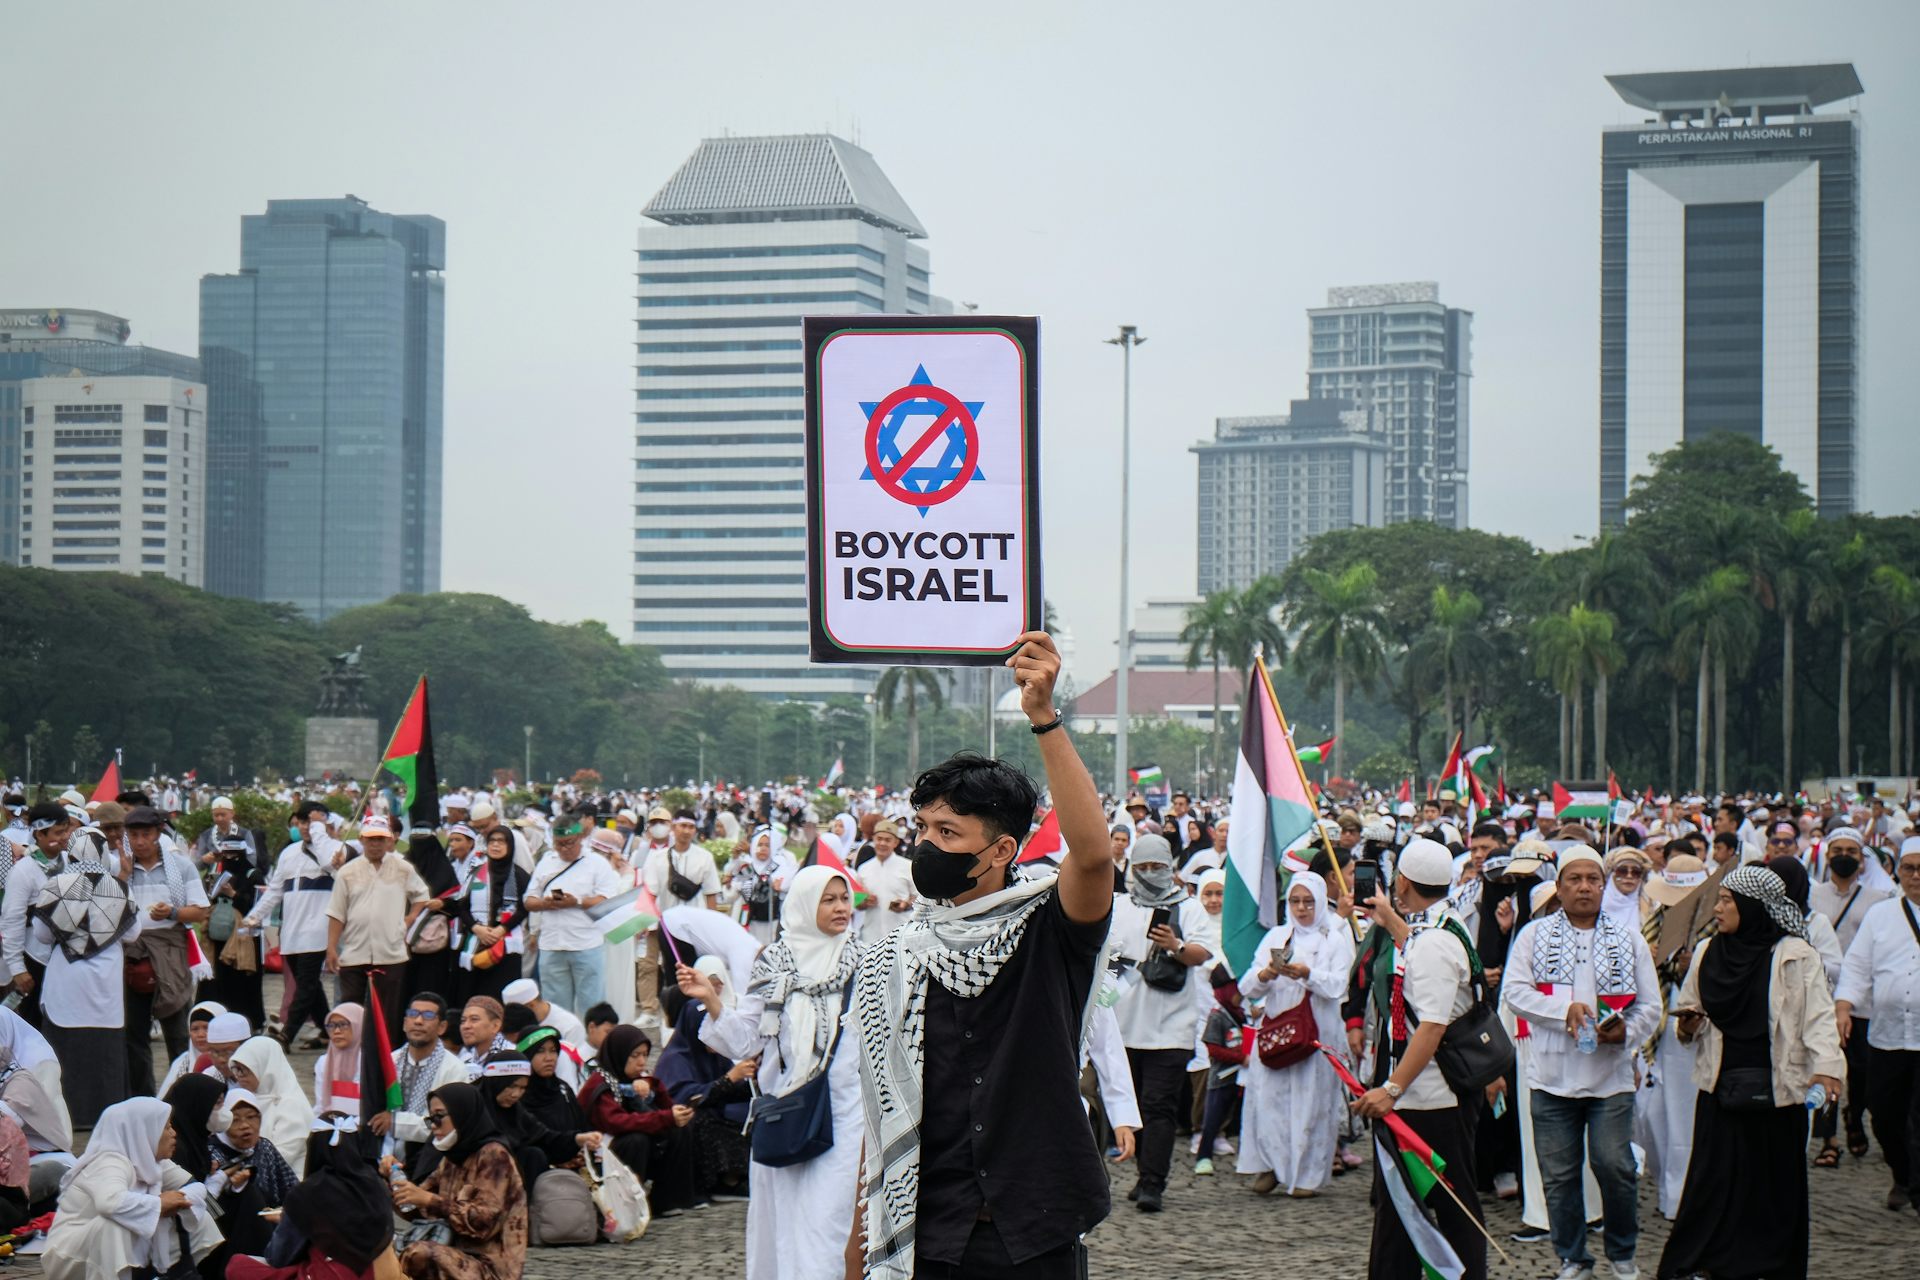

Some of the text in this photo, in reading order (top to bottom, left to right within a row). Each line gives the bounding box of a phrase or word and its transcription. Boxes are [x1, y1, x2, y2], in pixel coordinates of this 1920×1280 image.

[1638, 127, 1812, 144] PERPUSTAKAAN NASIONAL RI
[835, 531, 1015, 560] BOYCOTT
[843, 567, 1008, 602] ISRAEL
[1547, 942, 1561, 975] SAVE
